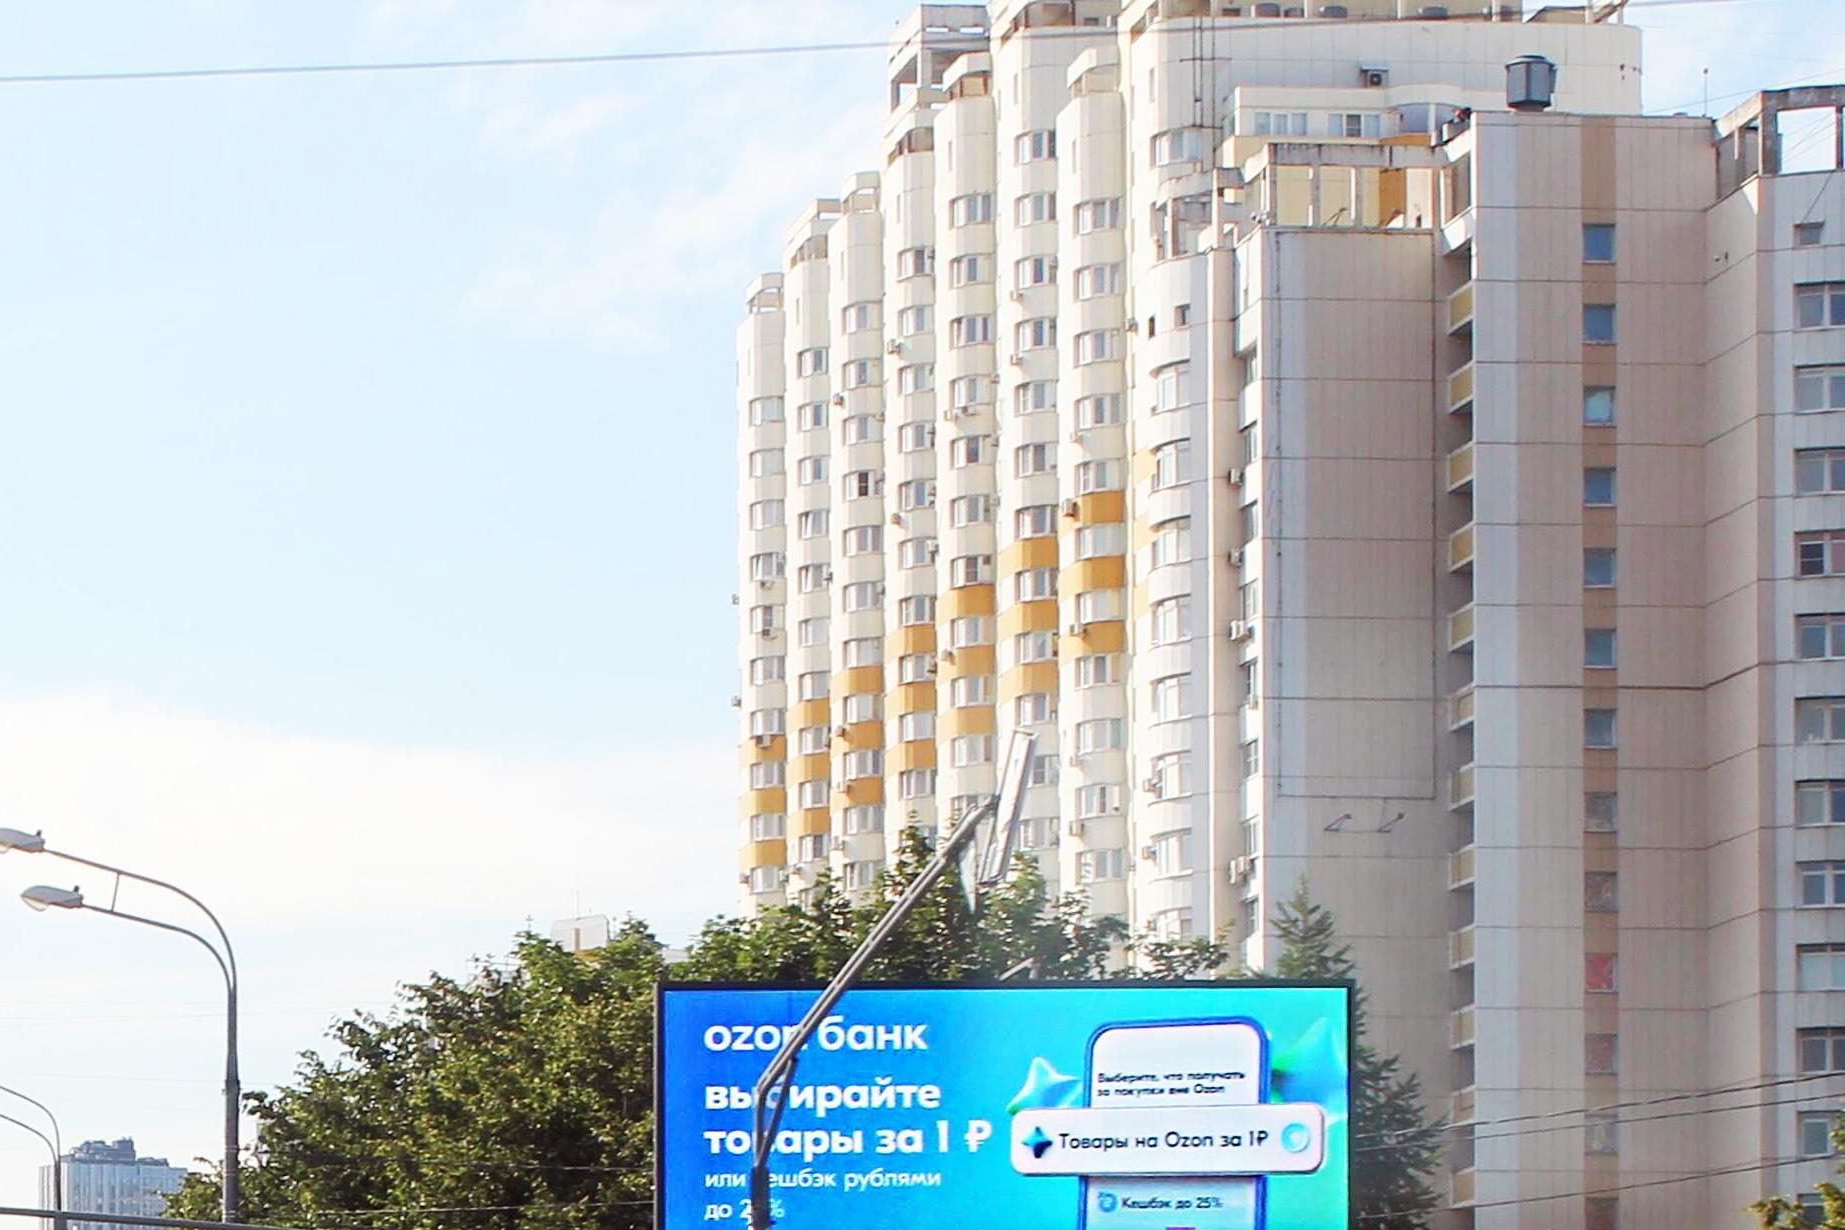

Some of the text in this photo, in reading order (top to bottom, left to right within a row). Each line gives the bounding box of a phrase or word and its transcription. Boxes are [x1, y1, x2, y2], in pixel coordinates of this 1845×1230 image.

[818, 1015, 928, 1050] банк
[704, 1129, 864, 1162] тоары
[875, 1129, 923, 1154] за
[936, 1120, 949, 1153] 1
[1059, 1132, 1128, 1151] Товары
[1135, 1136, 1158, 1149] на
[1165, 1130, 1213, 1148] Ozon
[1220, 1135, 1242, 1148] за
[705, 1168, 941, 1192] или ешбэк рублями
[704, 1198, 786, 1222] до 2%
[1175, 1201, 1191, 1210] до
